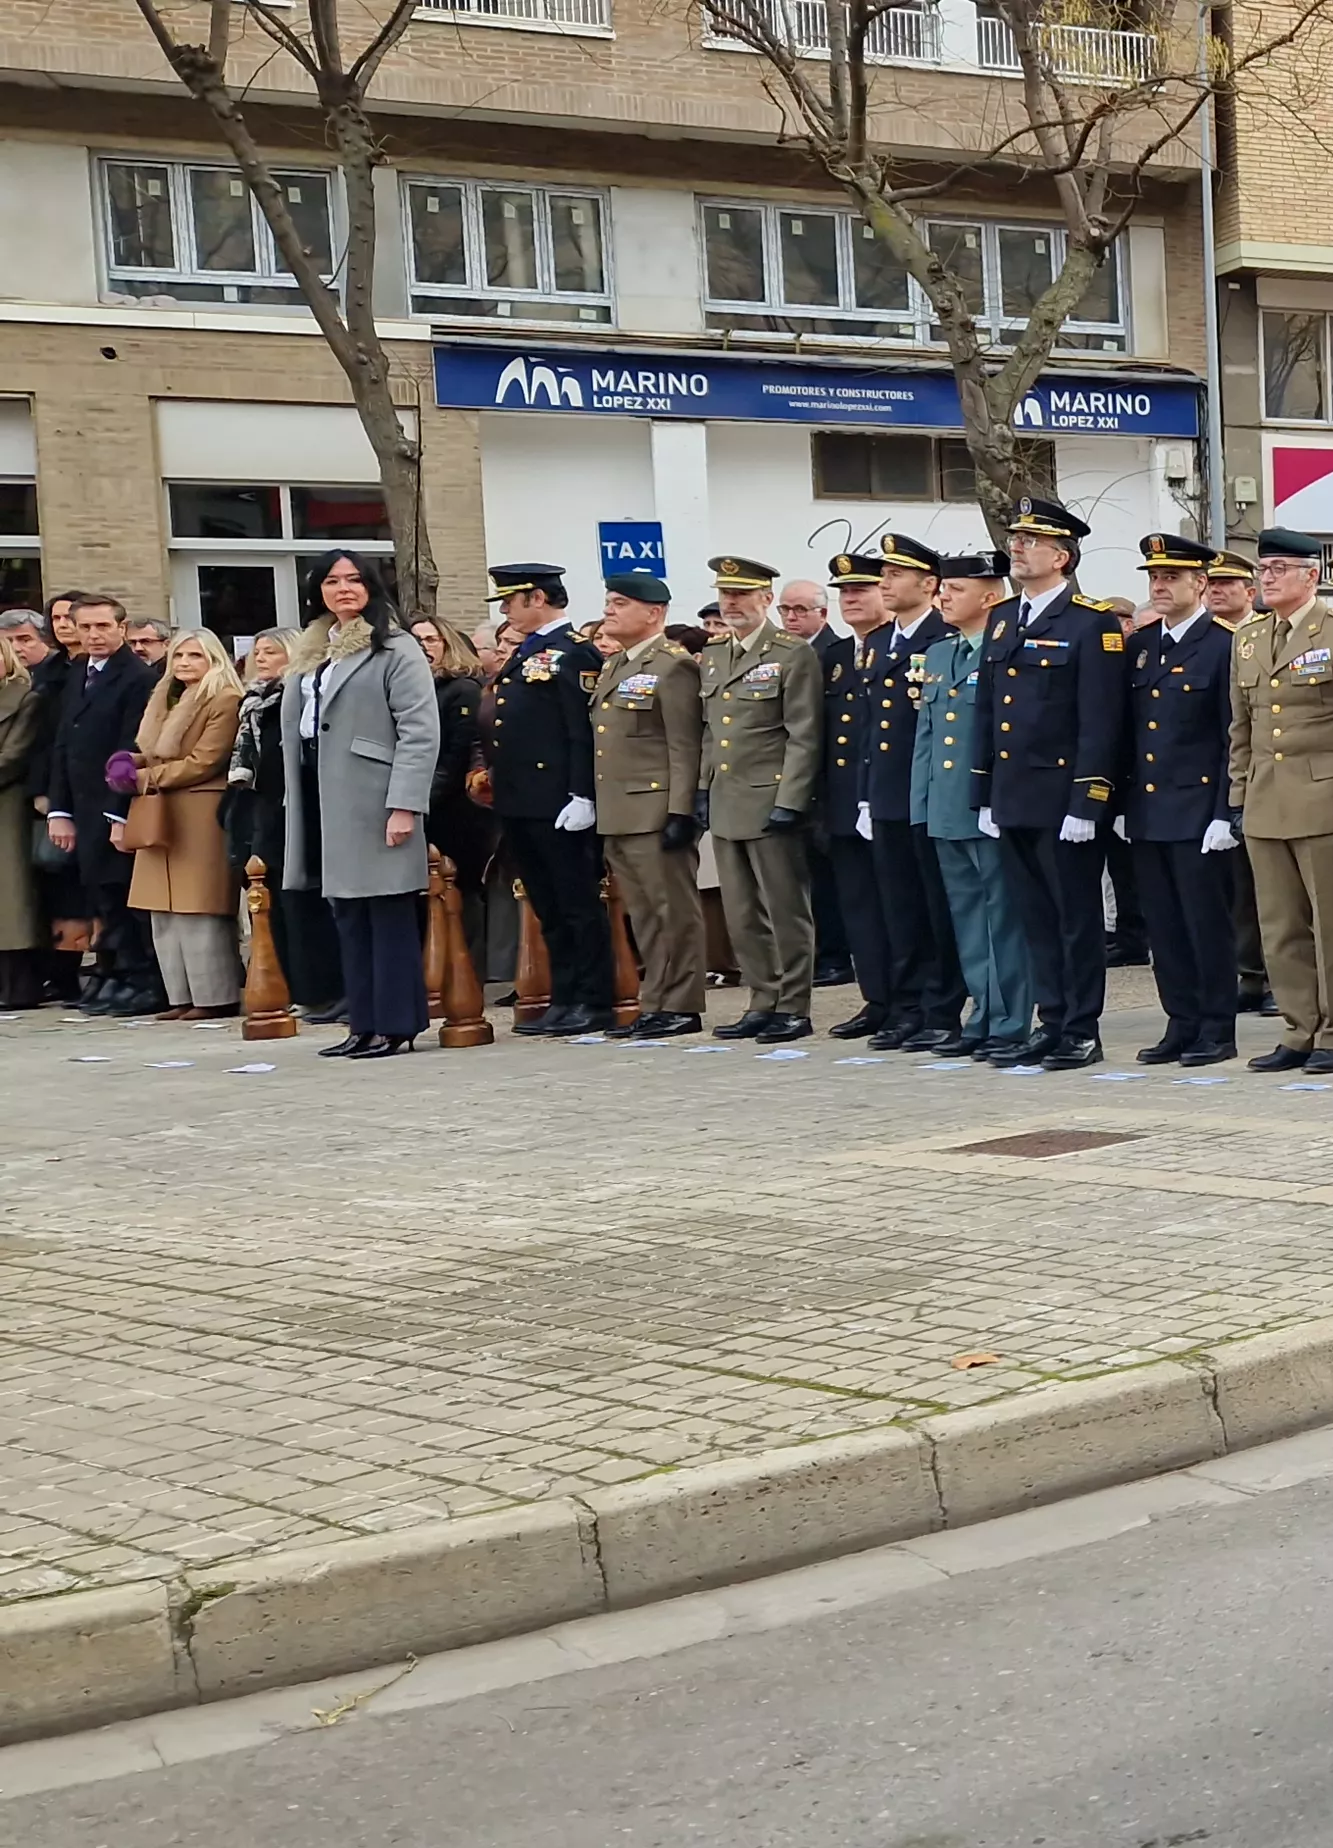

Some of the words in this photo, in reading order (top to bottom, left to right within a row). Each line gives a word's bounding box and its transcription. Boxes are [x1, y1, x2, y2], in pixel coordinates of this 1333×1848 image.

[591, 368, 709, 396] MARINO
[762, 384, 826, 397] PROMOTORES
[828, 388, 836, 397] Y
[836, 388, 914, 400] CONSTRUCTORES
[593, 395, 643, 410] LOPEZ
[646, 398, 671, 411] XXI
[1050, 390, 1151, 416] MARINO
[1051, 415, 1094, 428] LOPEZ
[1097, 416, 1119, 429] XXI
[601, 541, 664, 559] TAXI
